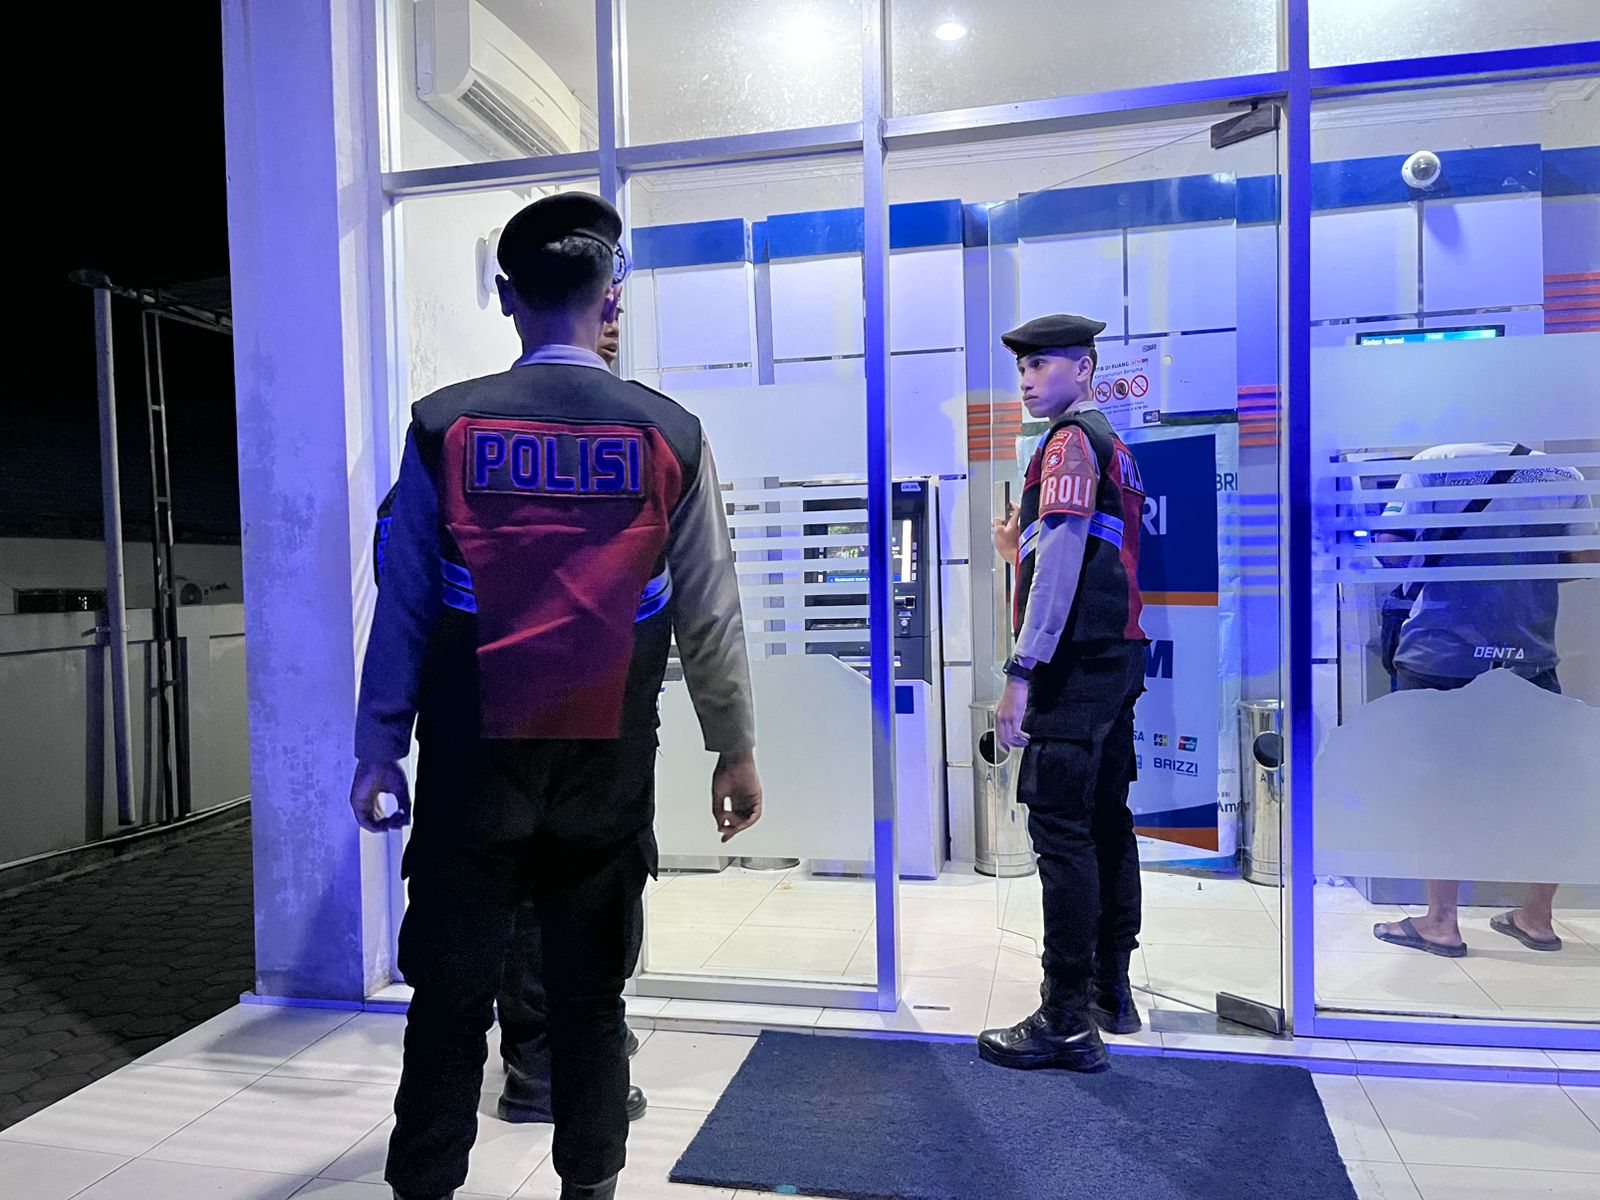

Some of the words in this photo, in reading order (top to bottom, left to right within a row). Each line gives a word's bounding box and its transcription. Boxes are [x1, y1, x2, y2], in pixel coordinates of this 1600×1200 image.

[474, 431, 641, 491] POLISI
[1216, 472, 1238, 491] BRI
[1473, 646, 1524, 659] DENTA
[1153, 757, 1198, 774] BRIZZI
